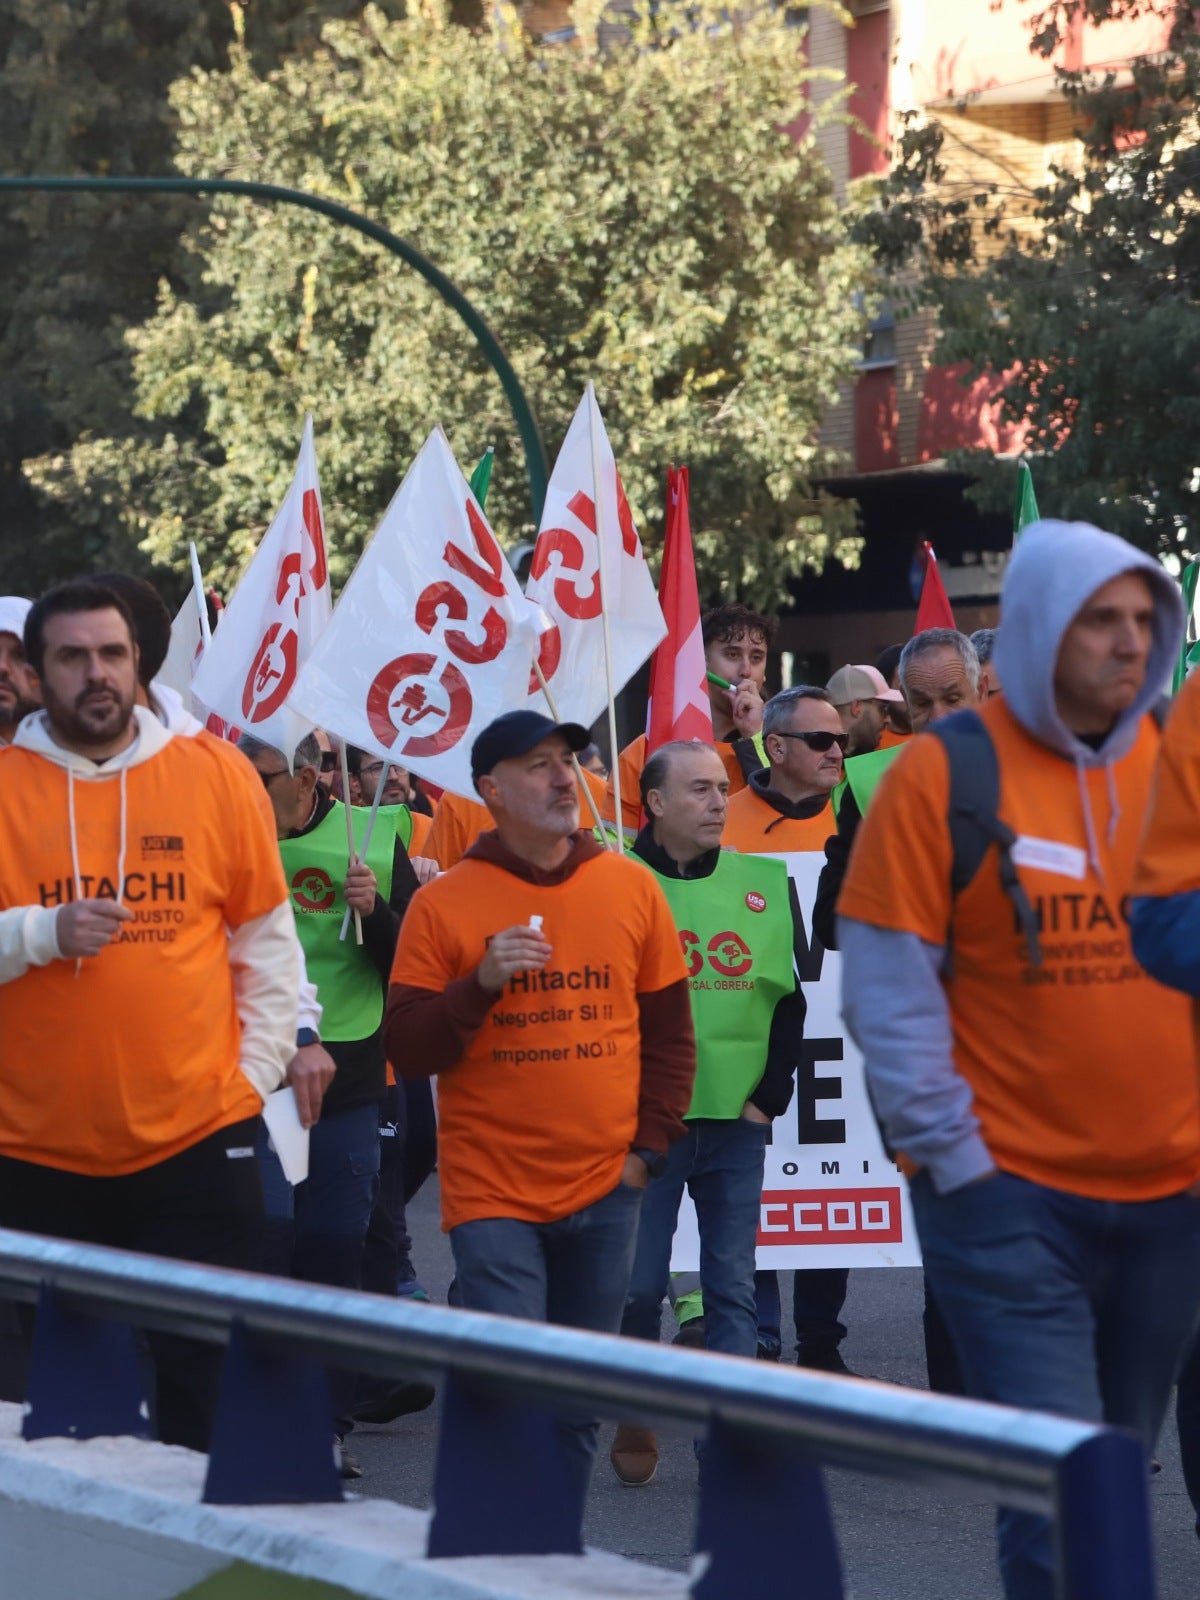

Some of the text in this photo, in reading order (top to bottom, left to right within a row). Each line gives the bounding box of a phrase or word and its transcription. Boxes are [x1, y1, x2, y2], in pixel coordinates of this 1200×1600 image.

[38, 872, 186, 908] HITACHI
[131, 909, 185, 924] JUSTO
[508, 964, 611, 994] Hitachi
[714, 980, 755, 991] OBRERA
[492, 1006, 575, 1028] Negociar
[579, 1004, 599, 1021] SI
[492, 1046, 571, 1067] Imponer
[576, 1041, 603, 1060] NO
[761, 1200, 891, 1233] CCOO
